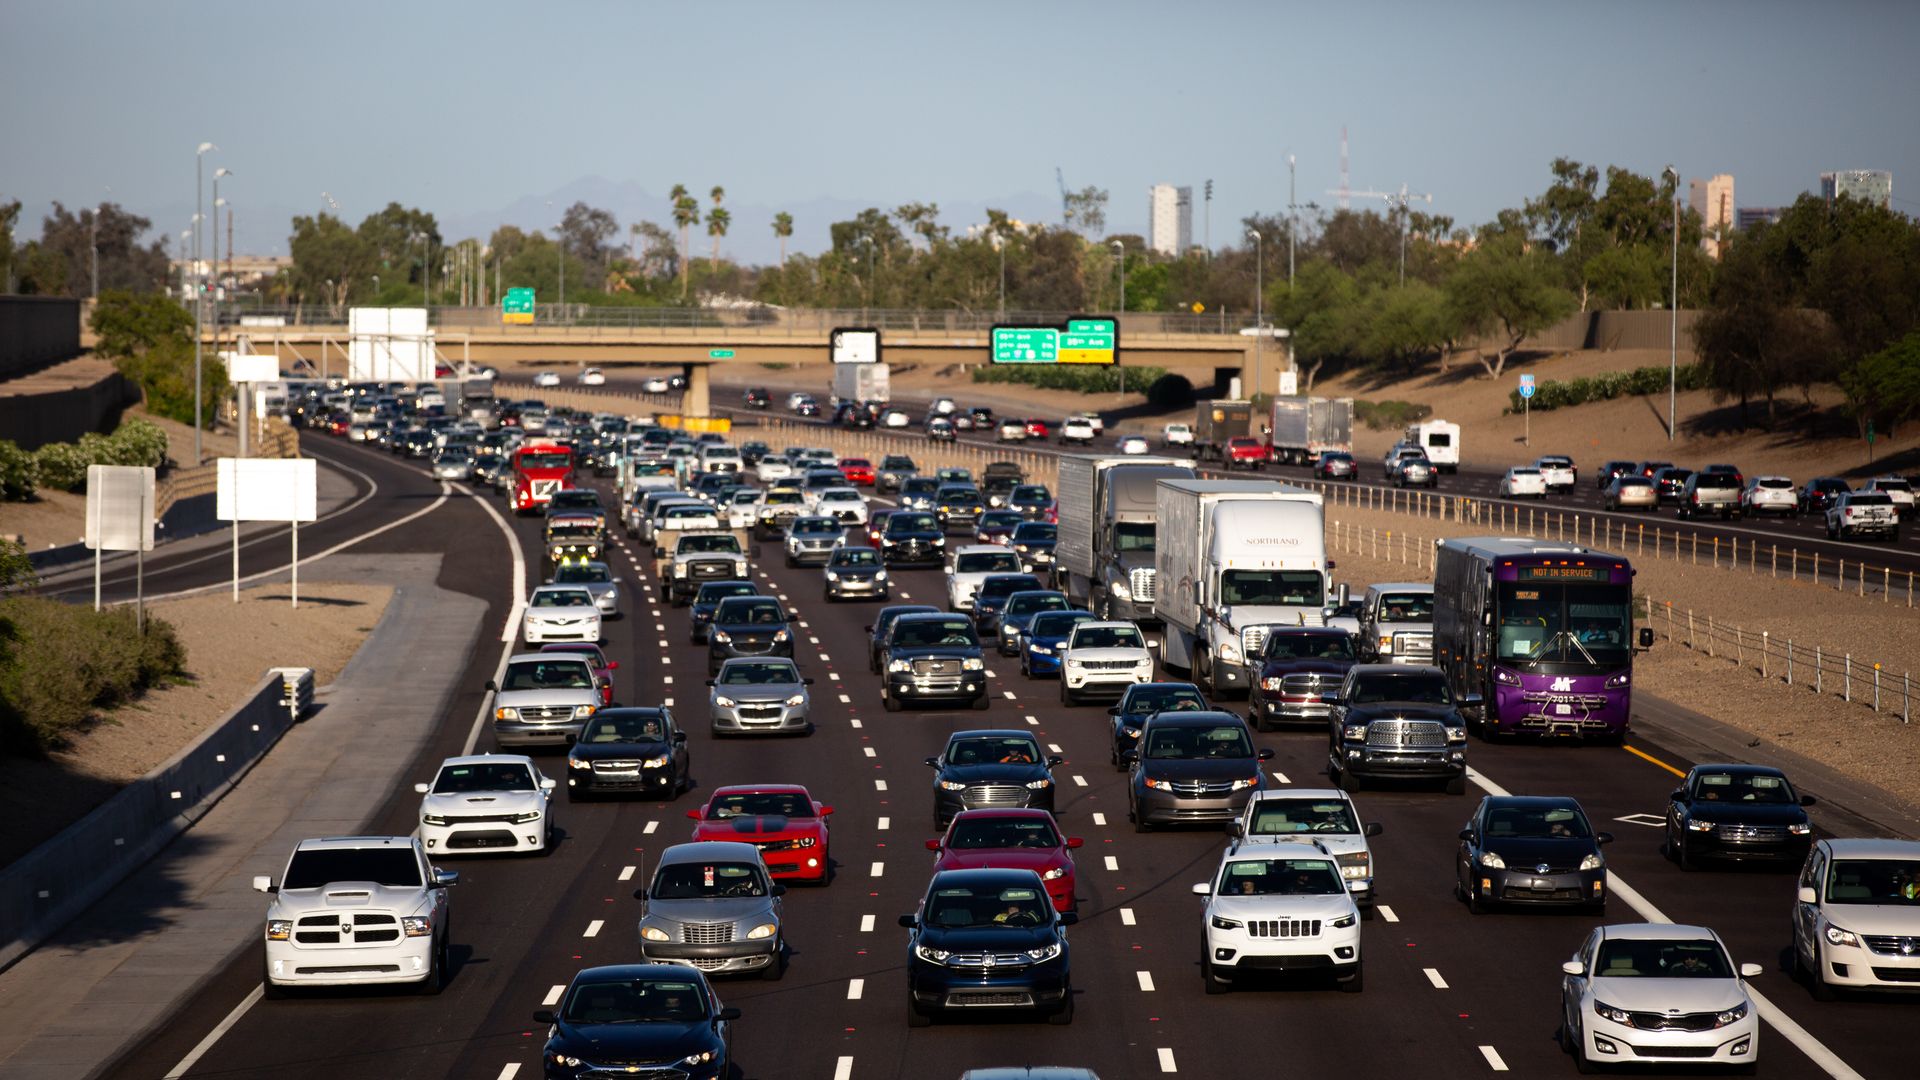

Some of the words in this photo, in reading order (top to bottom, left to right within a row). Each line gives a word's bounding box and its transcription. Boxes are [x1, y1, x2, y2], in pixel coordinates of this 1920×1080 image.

[1523, 386, 1532, 395] 10
[1246, 537, 1299, 545] NORTHLAND
[1533, 568, 1547, 577] NOT
[1550, 568, 1559, 577] IN
[1561, 568, 1593, 577] SERVICE
